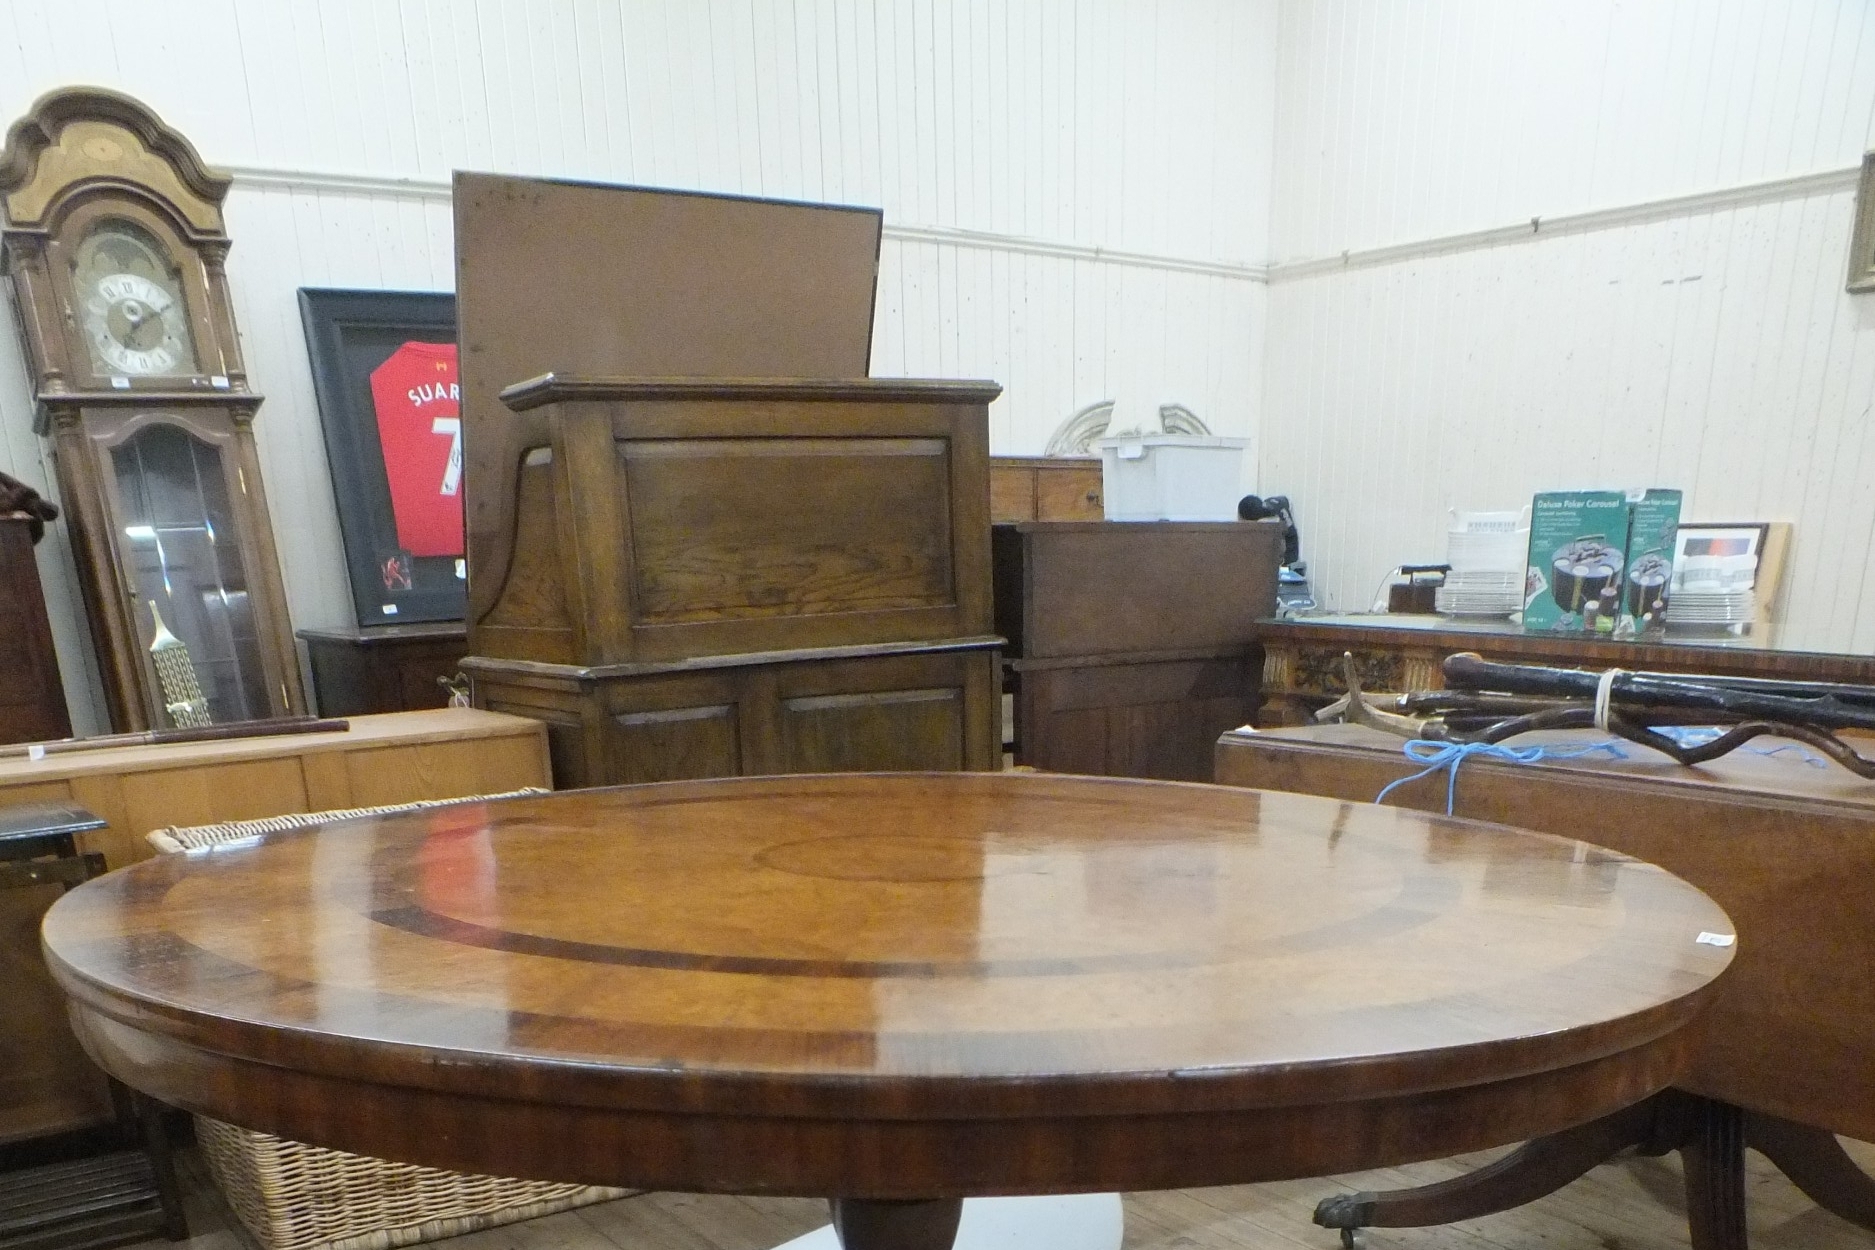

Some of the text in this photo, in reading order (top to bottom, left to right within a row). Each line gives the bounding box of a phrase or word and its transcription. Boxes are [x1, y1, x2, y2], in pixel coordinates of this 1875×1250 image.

[408, 382, 460, 407] SUAR
[432, 417, 462, 496] 7
[1537, 499, 1620, 508] Deluxe Poker Carousel
